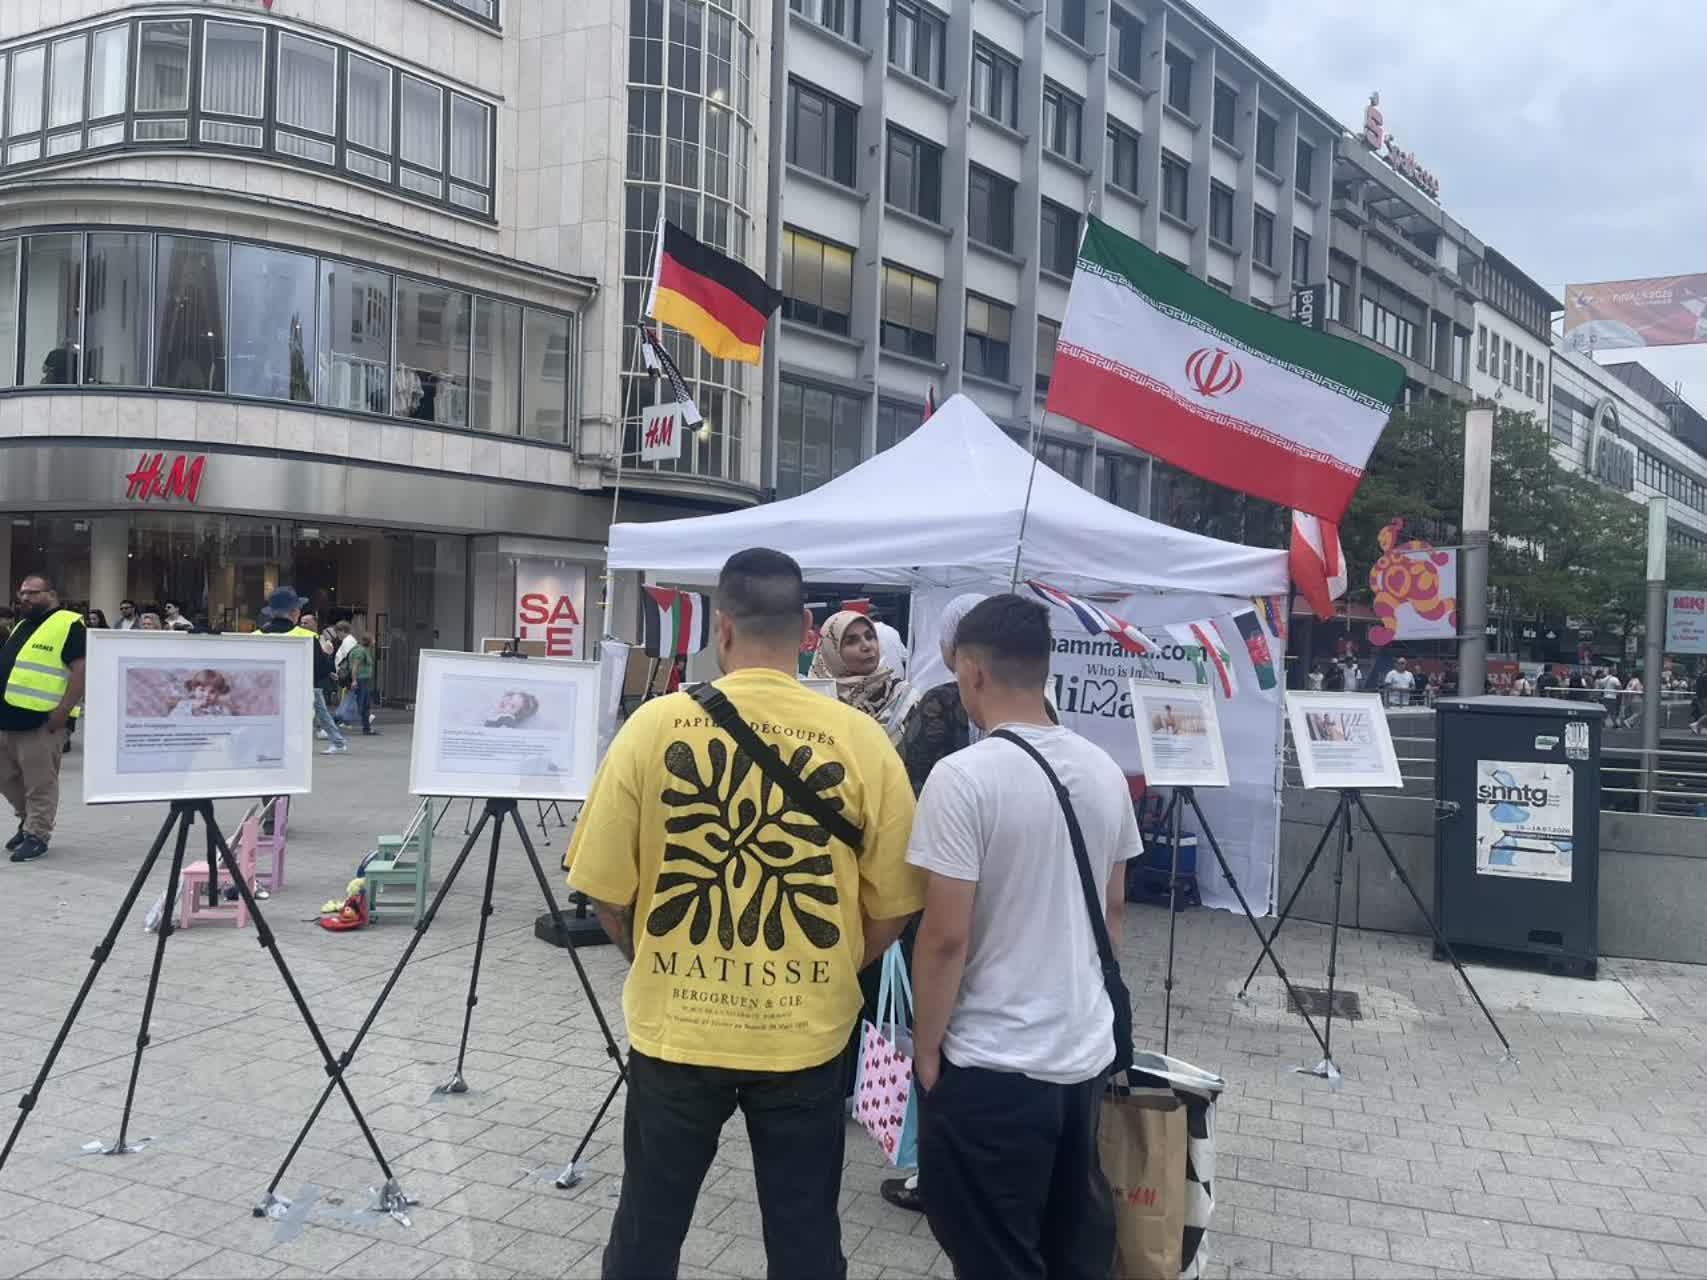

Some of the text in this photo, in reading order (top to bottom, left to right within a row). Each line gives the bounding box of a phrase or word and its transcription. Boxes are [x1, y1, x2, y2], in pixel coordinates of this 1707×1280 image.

[1298, 290, 1313, 328] ubel
[646, 415, 674, 448] H&M
[126, 452, 206, 503] H&M
[519, 593, 580, 625] SA
[1087, 664, 1115, 677] Who
[1117, 665, 1127, 678] is
[1478, 784, 1548, 807] snntg
[652, 951, 831, 988] MATISSE
[672, 988, 759, 1009] BERGGRUEN
